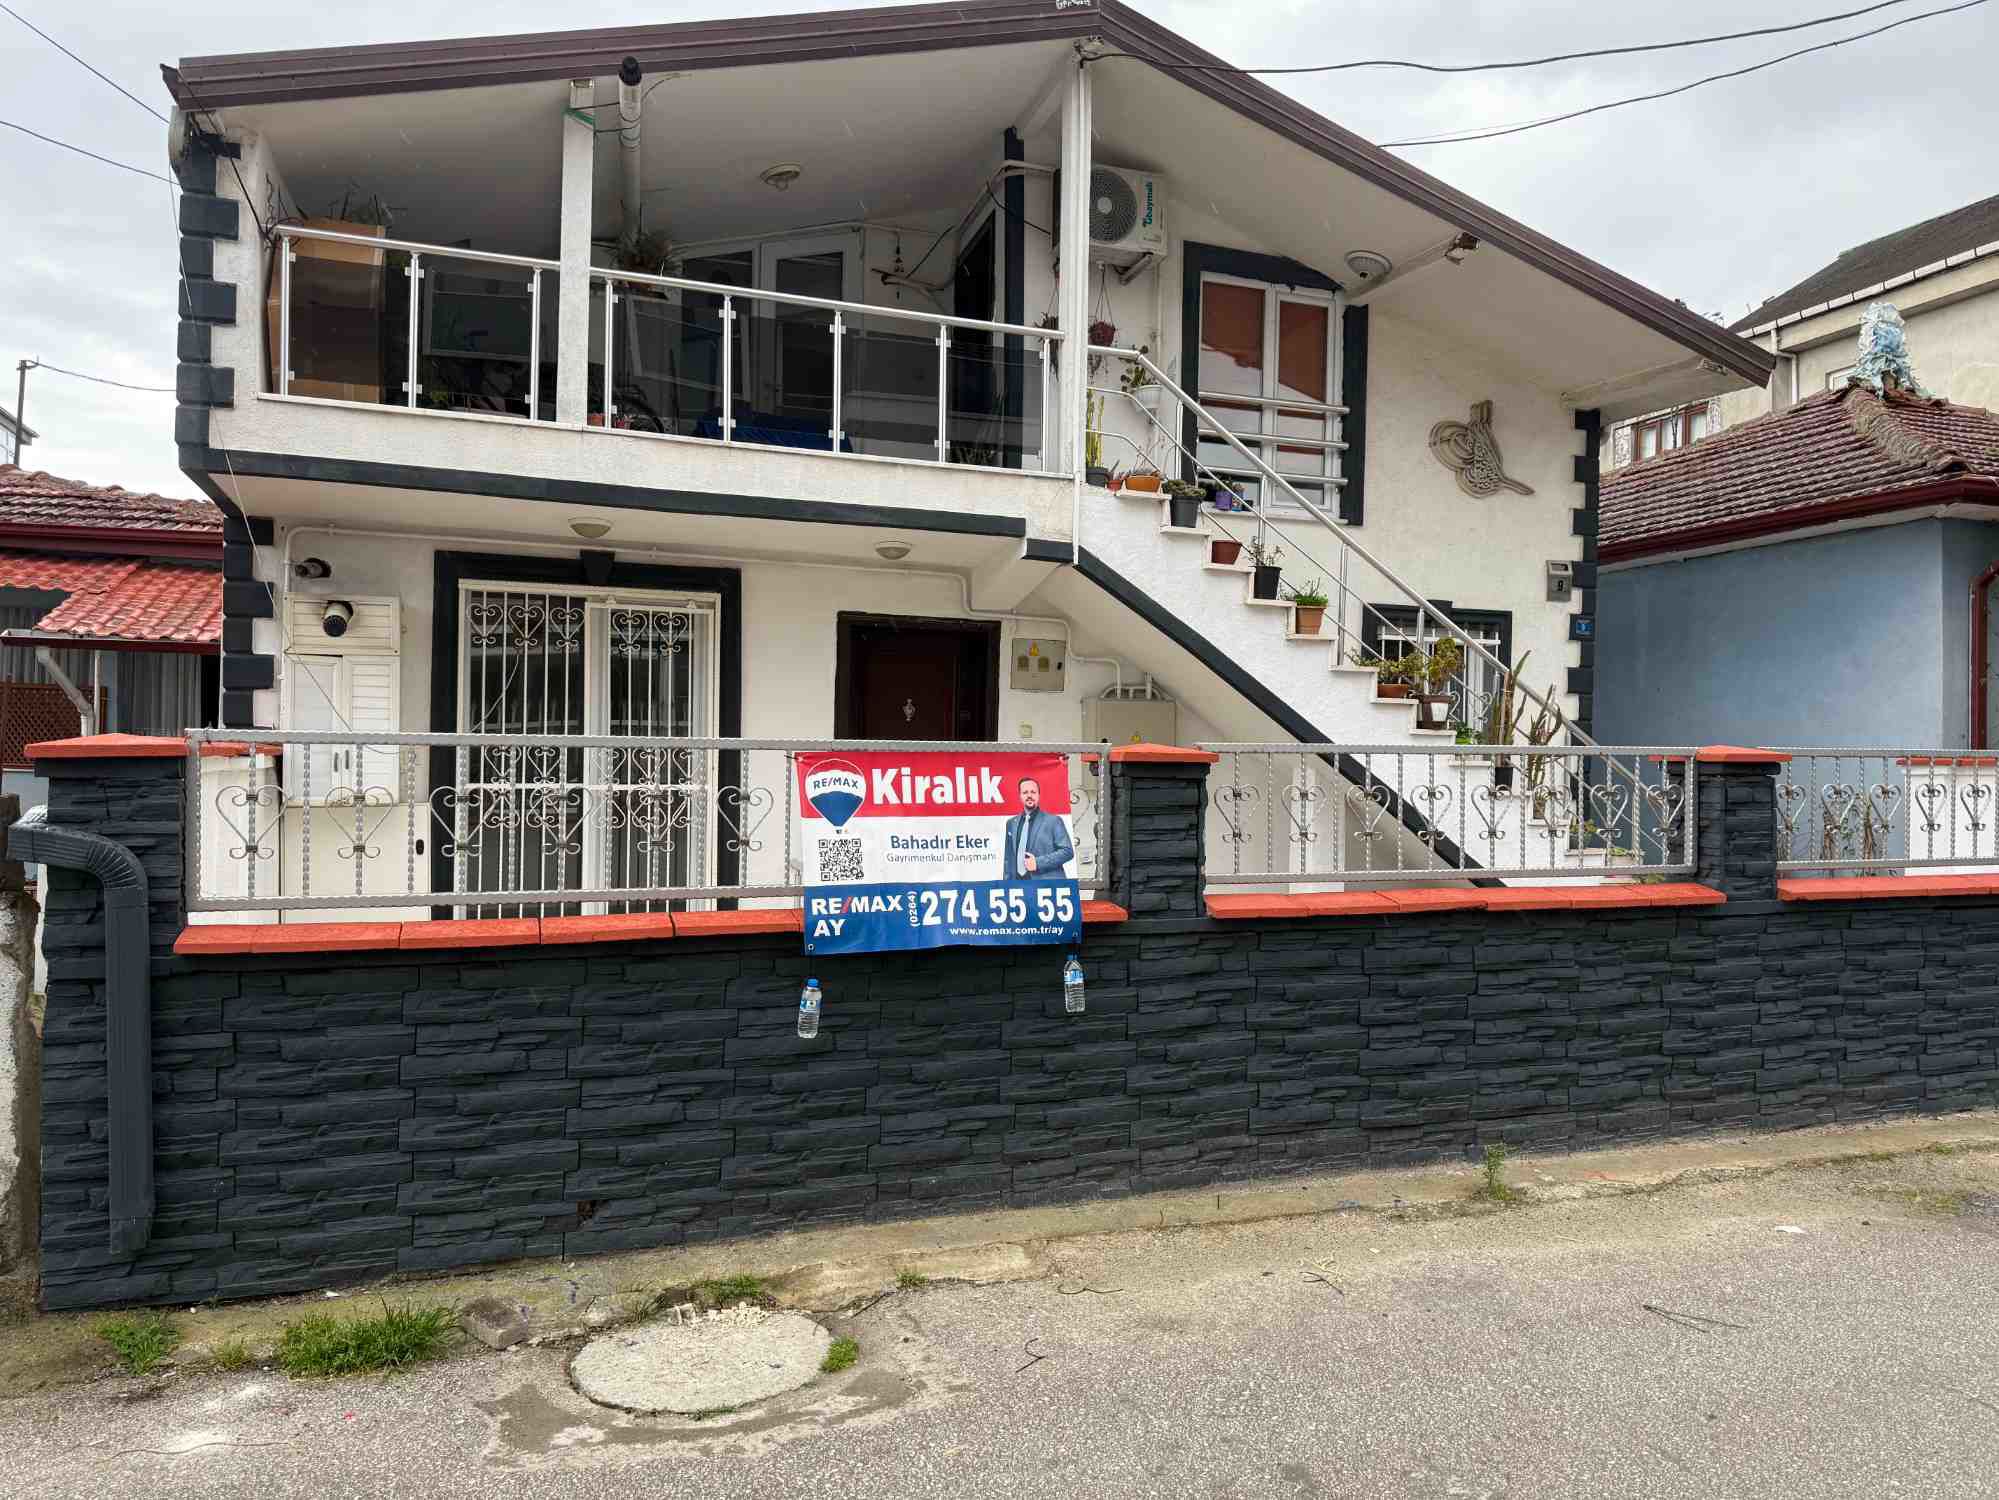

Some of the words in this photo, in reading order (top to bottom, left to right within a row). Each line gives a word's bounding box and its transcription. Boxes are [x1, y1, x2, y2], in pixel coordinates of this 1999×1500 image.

[813, 777, 859, 790] RE/MAX
[871, 766, 1005, 805] Kiralık
[890, 835, 951, 849] Bahadır
[956, 834, 990, 848] Eker
[811, 895, 904, 916] RE/MAX
[920, 889, 980, 926] 274
[989, 889, 1027, 924] 55
[1037, 887, 1074, 922] 55
[813, 919, 847, 937] AY
[949, 926, 1064, 936] www.remax.com.tr/ay
